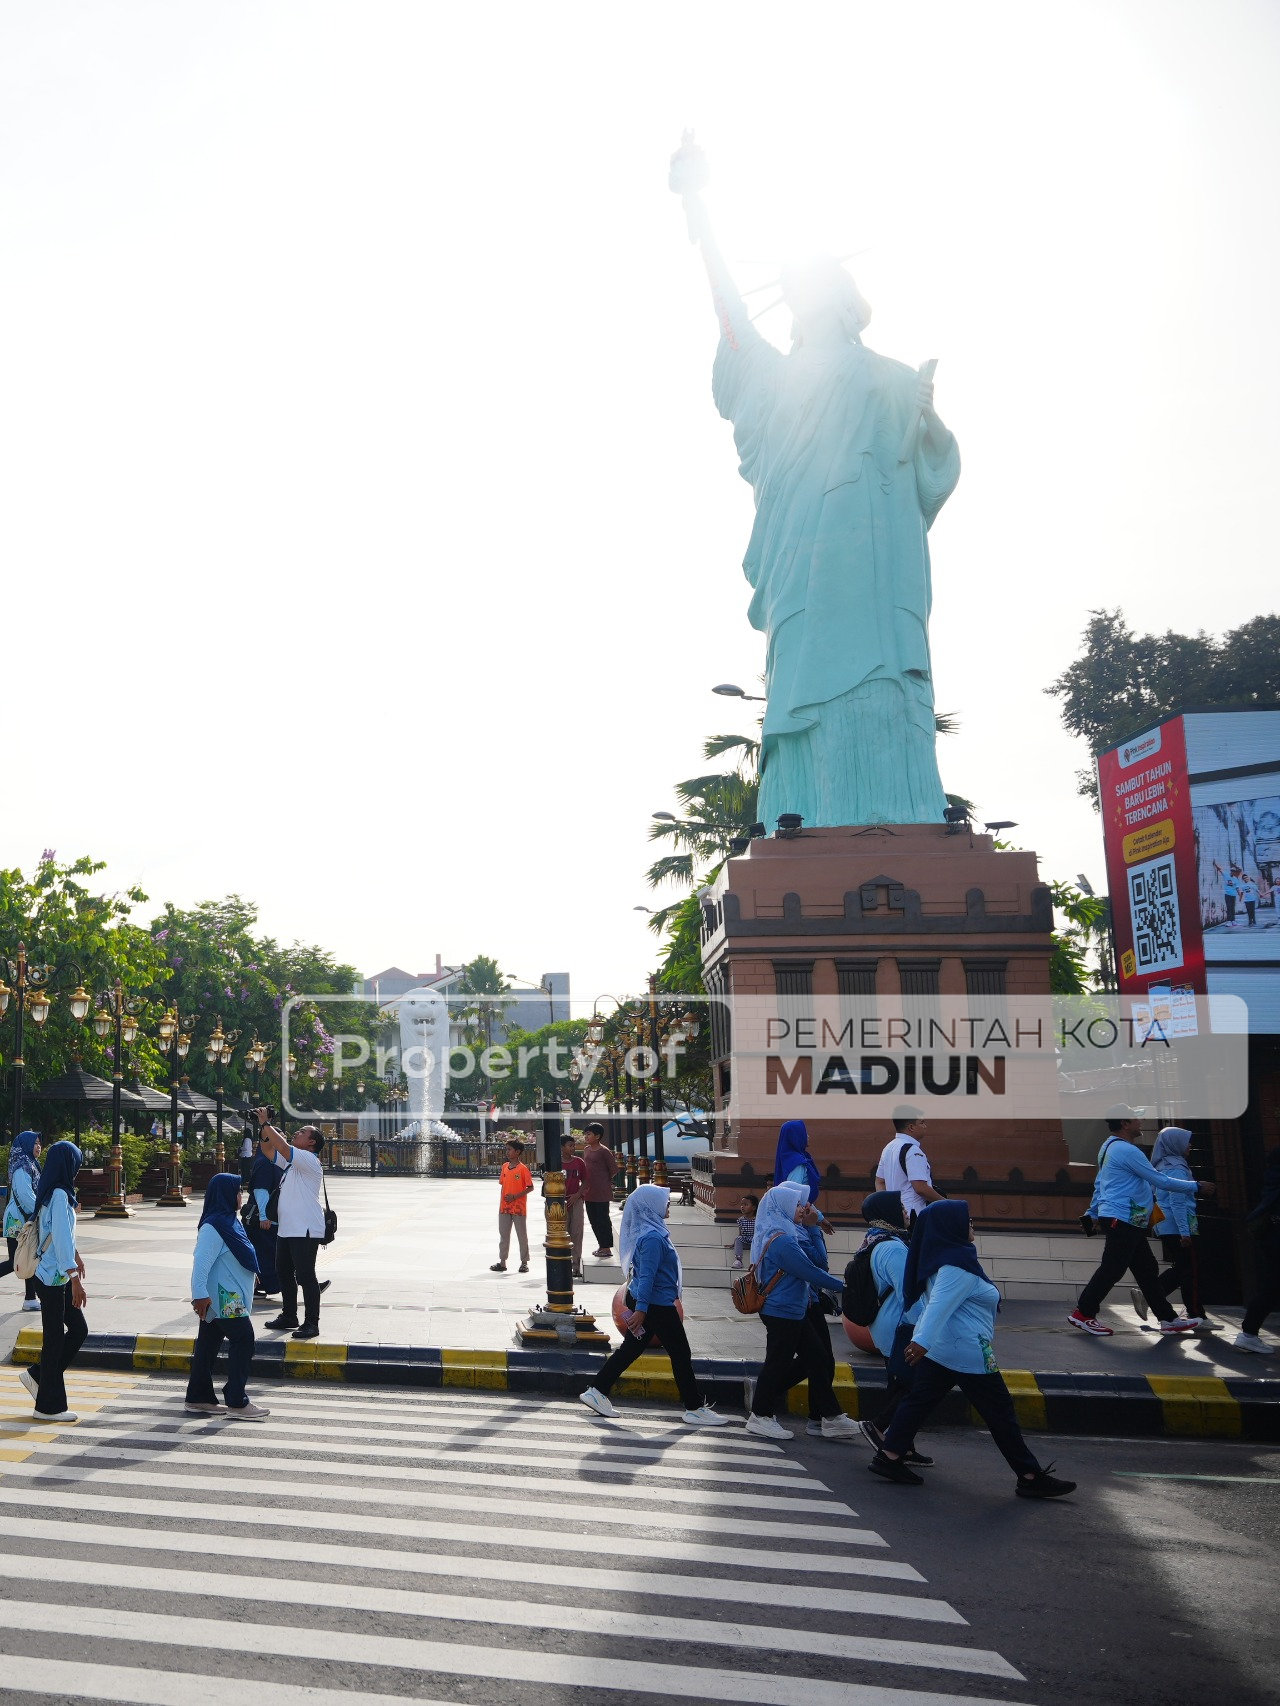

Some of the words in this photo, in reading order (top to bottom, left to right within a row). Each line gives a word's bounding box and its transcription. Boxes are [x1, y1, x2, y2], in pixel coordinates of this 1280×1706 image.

[1116, 773, 1145, 796] SAMBUT
[1146, 760, 1172, 782] TAHUN
[1124, 789, 1144, 809] BARU
[1145, 781, 1165, 800] LEBIH
[1124, 797, 1168, 825] TERENCANA
